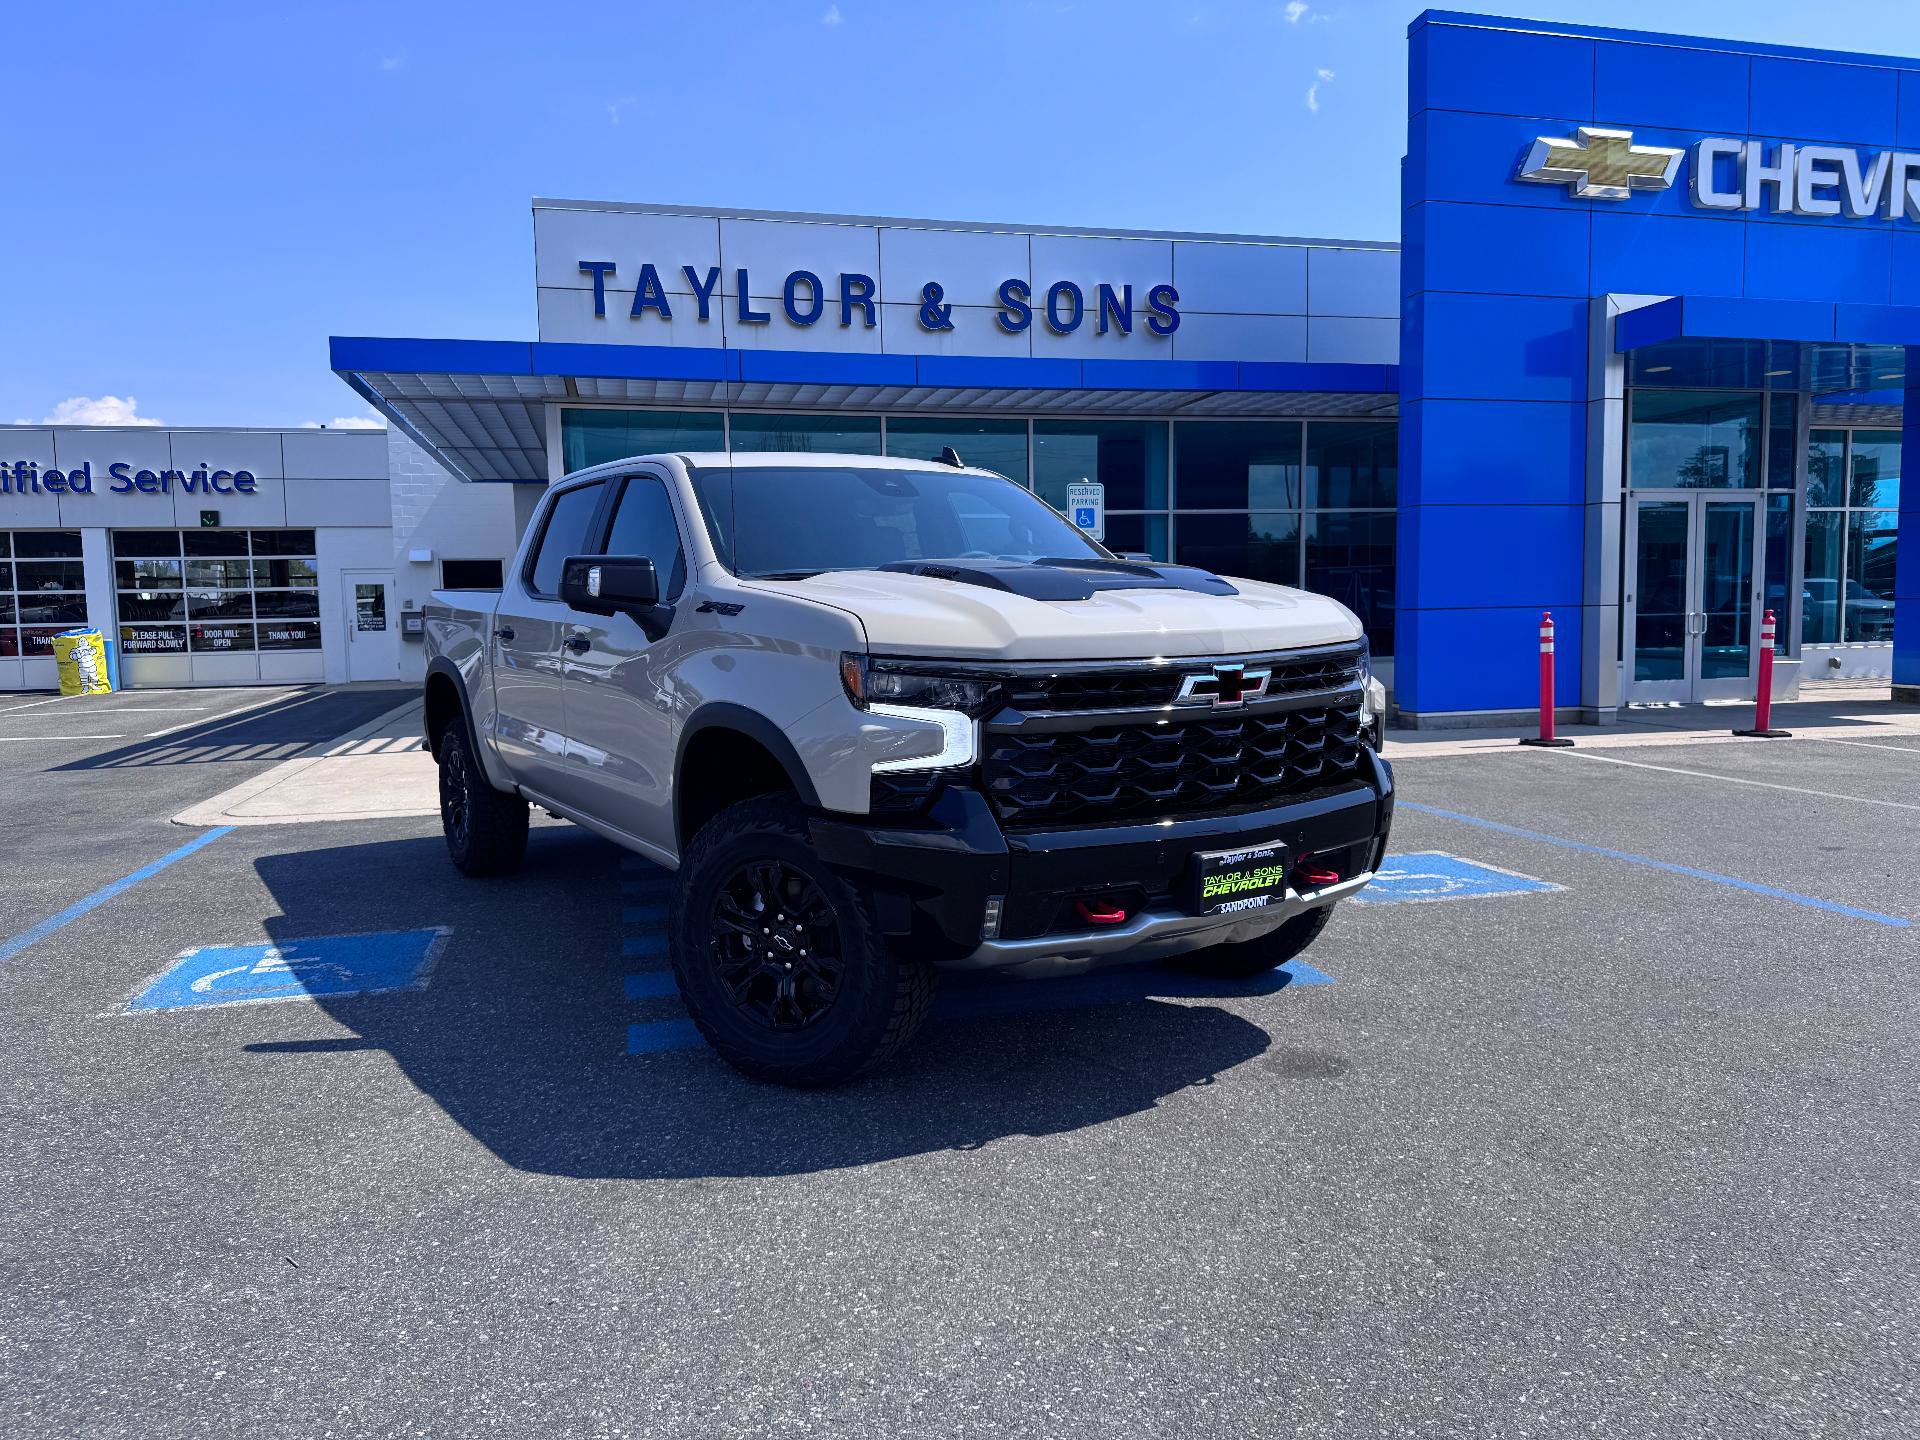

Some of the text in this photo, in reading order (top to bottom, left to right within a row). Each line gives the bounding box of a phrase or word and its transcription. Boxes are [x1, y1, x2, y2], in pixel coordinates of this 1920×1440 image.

[578, 260, 1181, 336] TAYLOR & SONS
[108, 462, 256, 494] Service
[1069, 488, 1100, 496] RESERVED
[1071, 498, 1099, 506] PARKING
[132, 631, 175, 640] PLEASE PULL
[204, 629, 240, 638] DOOR WILL
[268, 630, 306, 640] THANK YOU!
[32, 636, 53, 645] THAN
[123, 639, 184, 649] FORWARD SLOWLY
[213, 638, 231, 647] OPEN
[1222, 853, 1247, 865] Taylor
[1253, 849, 1271, 859] Sons
[1203, 865, 1283, 886] TAYLOR & SONS
[1203, 874, 1283, 898] CHEVROLET
[1220, 895, 1269, 914] SANDPOINT
